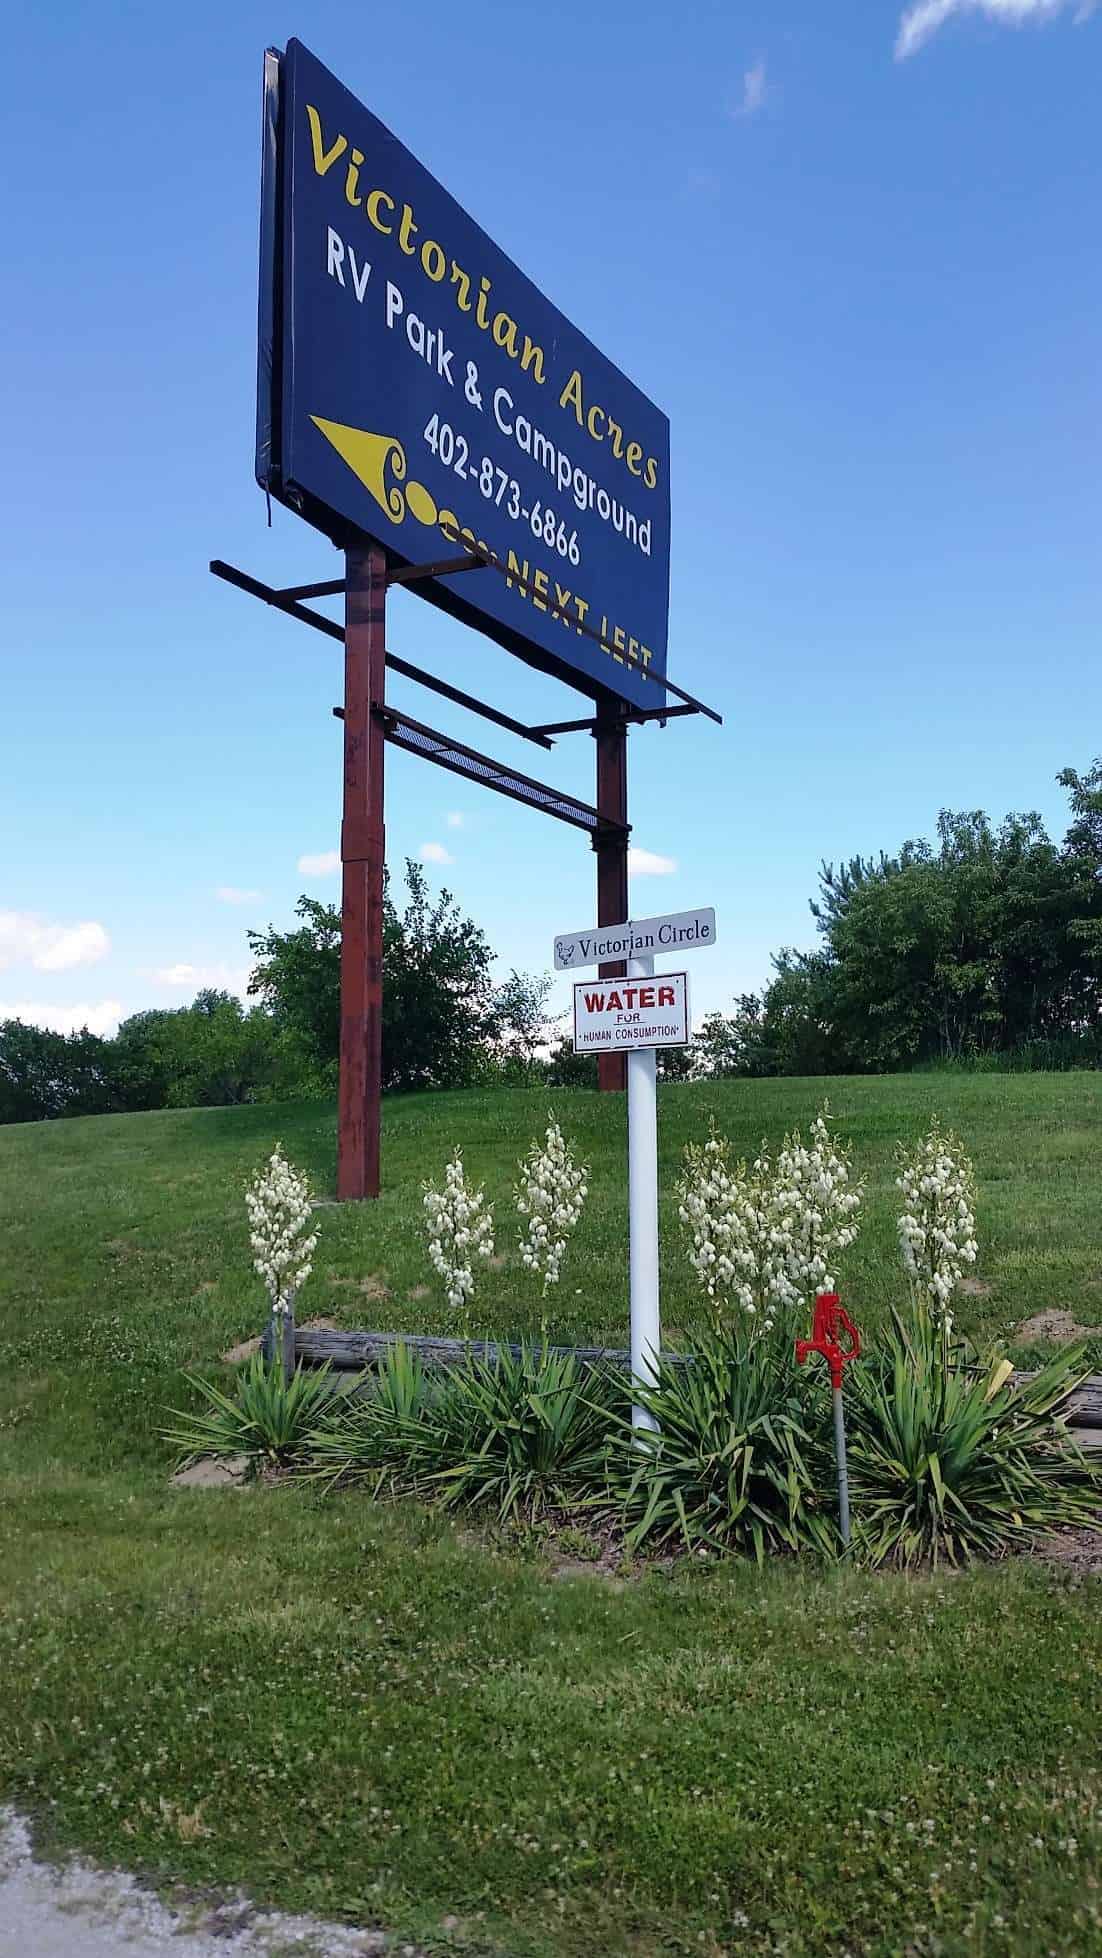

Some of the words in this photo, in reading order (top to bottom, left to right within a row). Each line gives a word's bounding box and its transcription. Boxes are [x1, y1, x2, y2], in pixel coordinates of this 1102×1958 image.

[306, 103, 546, 385] Victorian
[559, 369, 659, 490] Acres
[326, 225, 372, 304] RV
[386, 280, 455, 386] Park
[464, 359, 484, 411] &
[493, 386, 652, 557] Campground
[423, 413, 581, 567] 402-873-6866
[505, 549, 590, 636] NEXT
[600, 615, 653, 681] LEFT
[578, 931, 654, 957] Victorian
[658, 919, 710, 944] Circle
[583, 1030, 612, 1043] HUMAN
[615, 1025, 677, 1041] CONSUMPTION
[584, 985, 675, 1013] WATER
[616, 1013, 640, 1023] FOR
